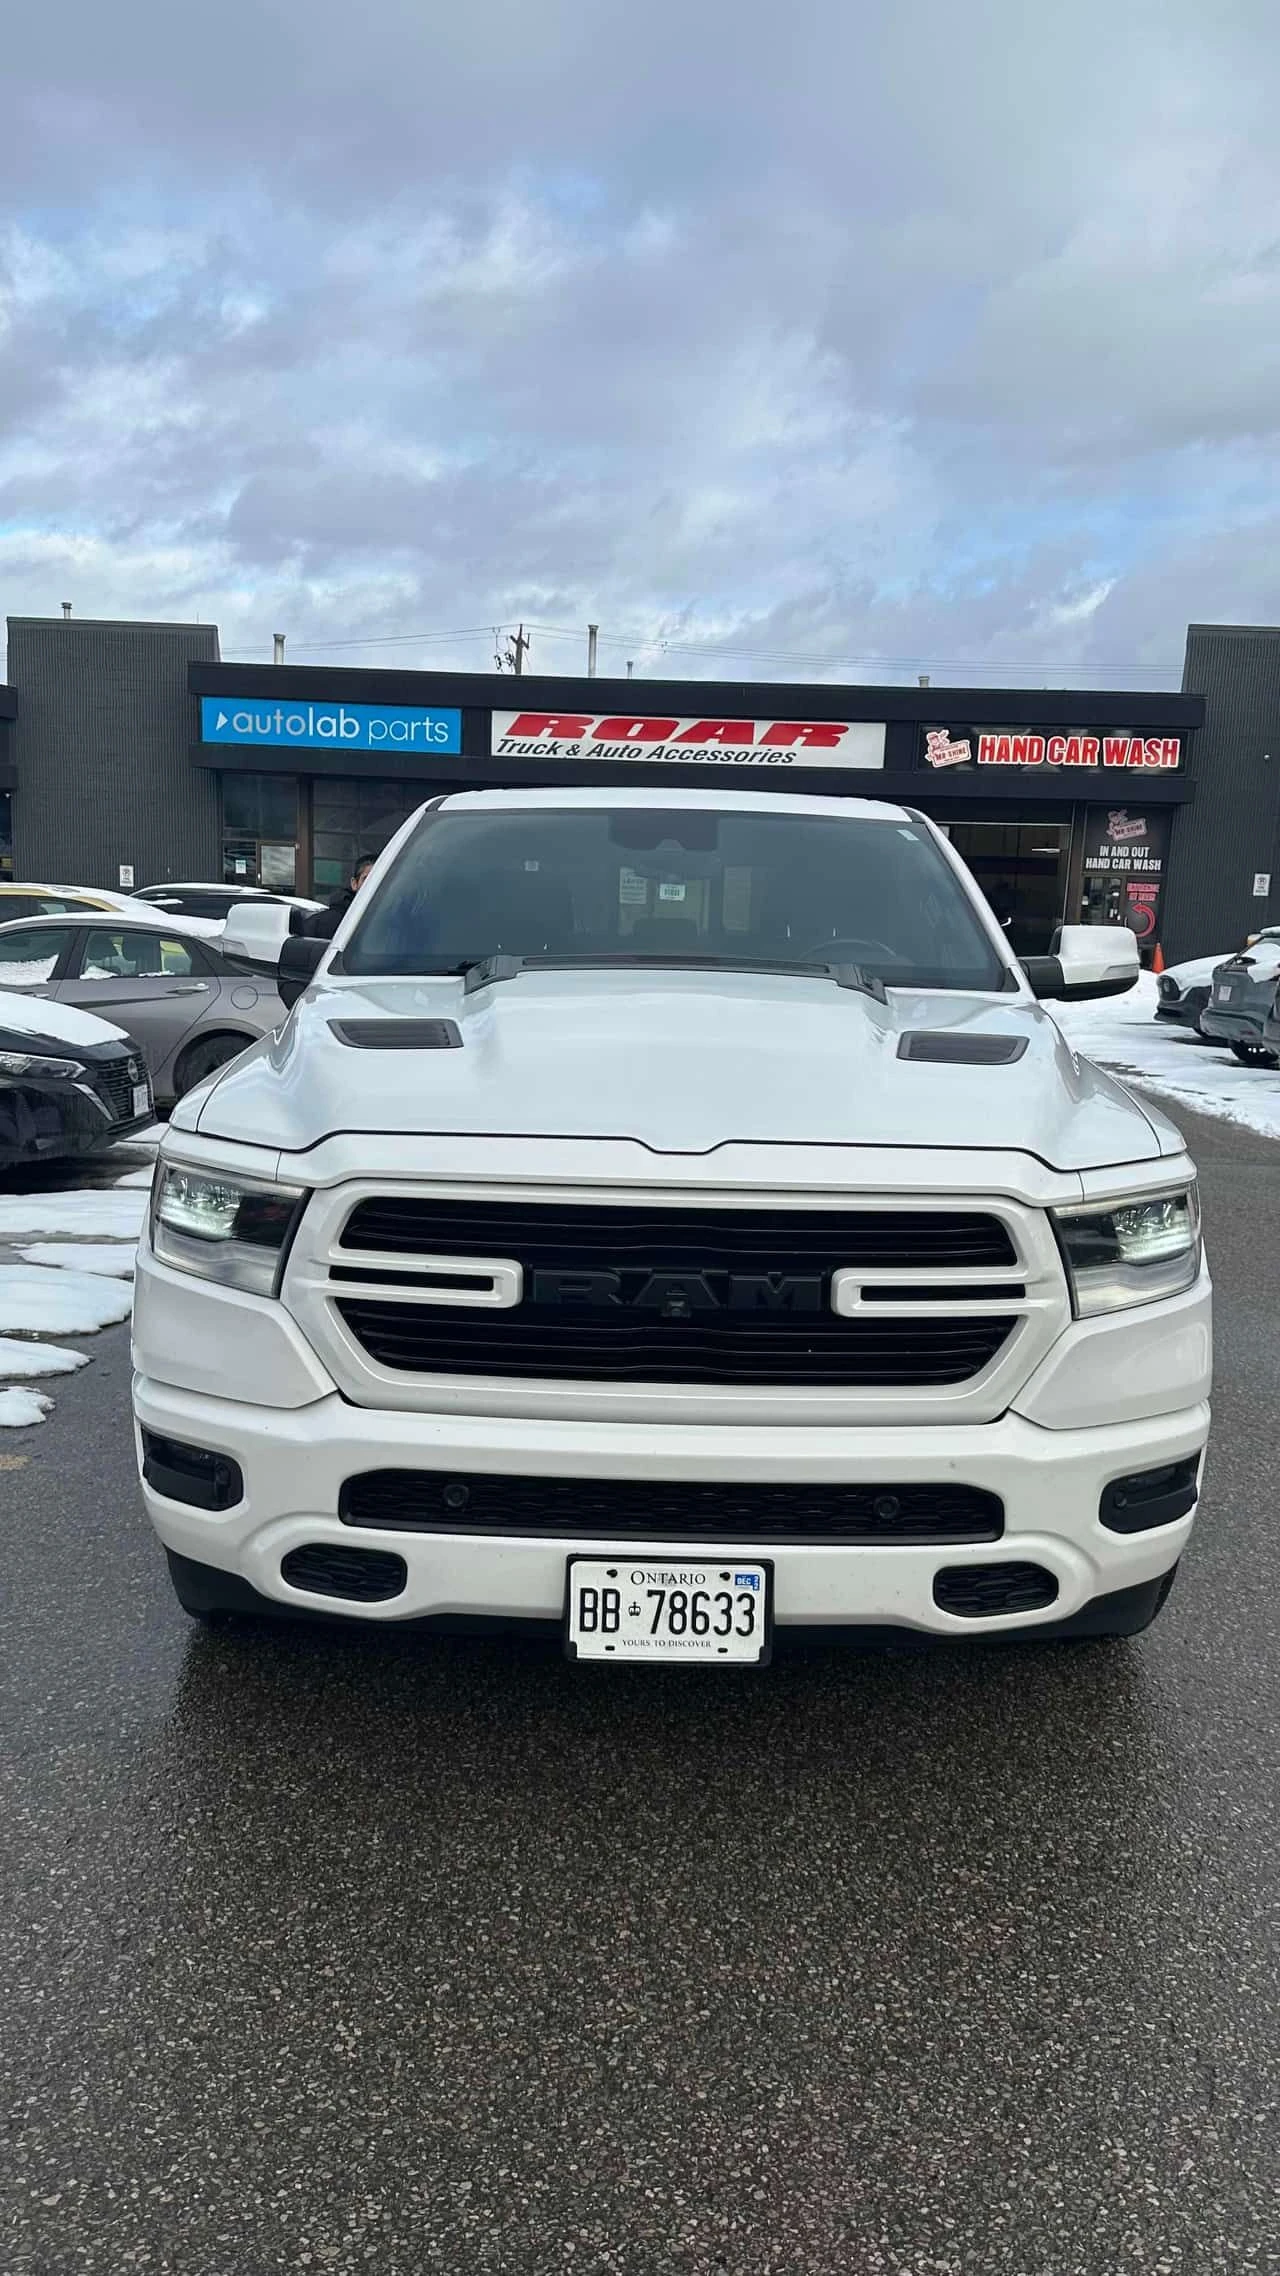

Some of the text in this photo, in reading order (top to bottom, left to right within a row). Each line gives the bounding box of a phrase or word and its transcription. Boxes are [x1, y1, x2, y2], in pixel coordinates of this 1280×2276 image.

[232, 707, 449, 745] autolab parts
[505, 713, 850, 748] ROAR
[496, 739, 797, 764] Truck & Auto Accessories
[978, 735, 1181, 768] HAND CAR WASH
[1085, 857, 1162, 871] HAND CAR WASH
[1100, 845, 1150, 858] IN AND OUT
[533, 1268, 822, 1311] RAM
[630, 1570, 706, 1586] ONTARIO
[579, 1587, 756, 1637] BB 78633
[622, 1639, 711, 1648] YOURS TO DISCOVER
